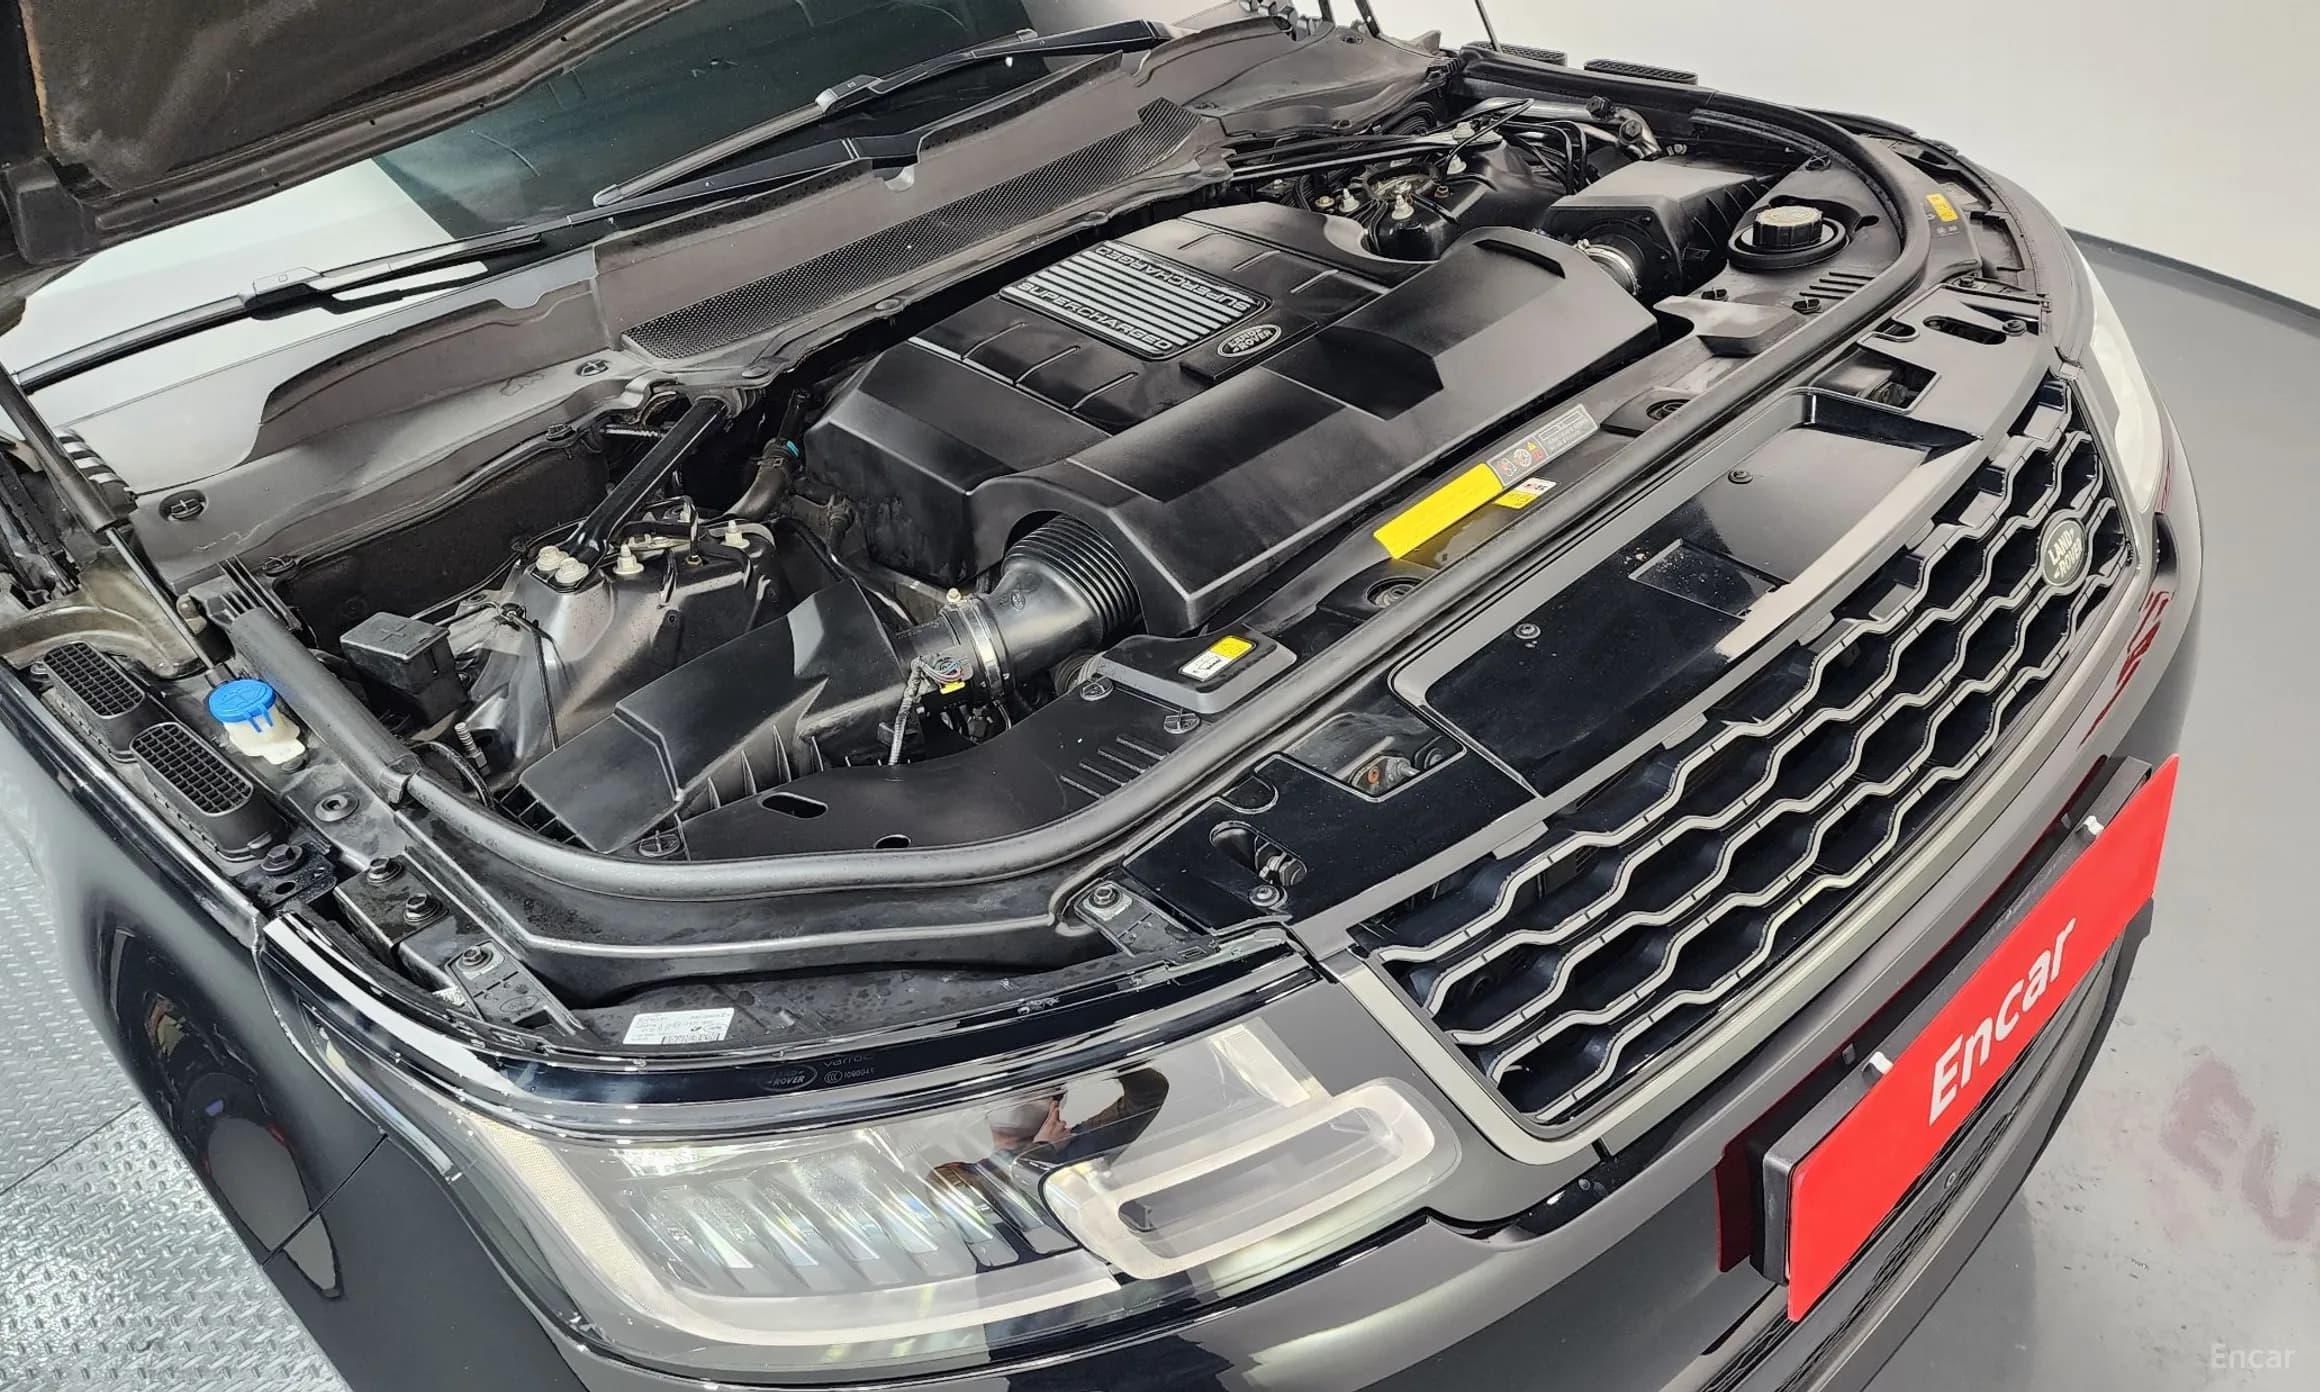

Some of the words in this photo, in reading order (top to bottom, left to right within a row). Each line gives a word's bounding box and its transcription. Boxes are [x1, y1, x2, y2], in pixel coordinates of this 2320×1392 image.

[1096, 246, 1250, 312] SUPERCHARGED
[1016, 281, 1174, 351] SUPERCHARGED
[1227, 329, 1258, 348] LAND
[1237, 328, 1273, 351] ROVER
[2047, 529, 2074, 566] LAND
[2058, 537, 2083, 579] ROVER
[1928, 916, 2078, 1126] Encar
[772, 1074, 806, 1087] ROVER
